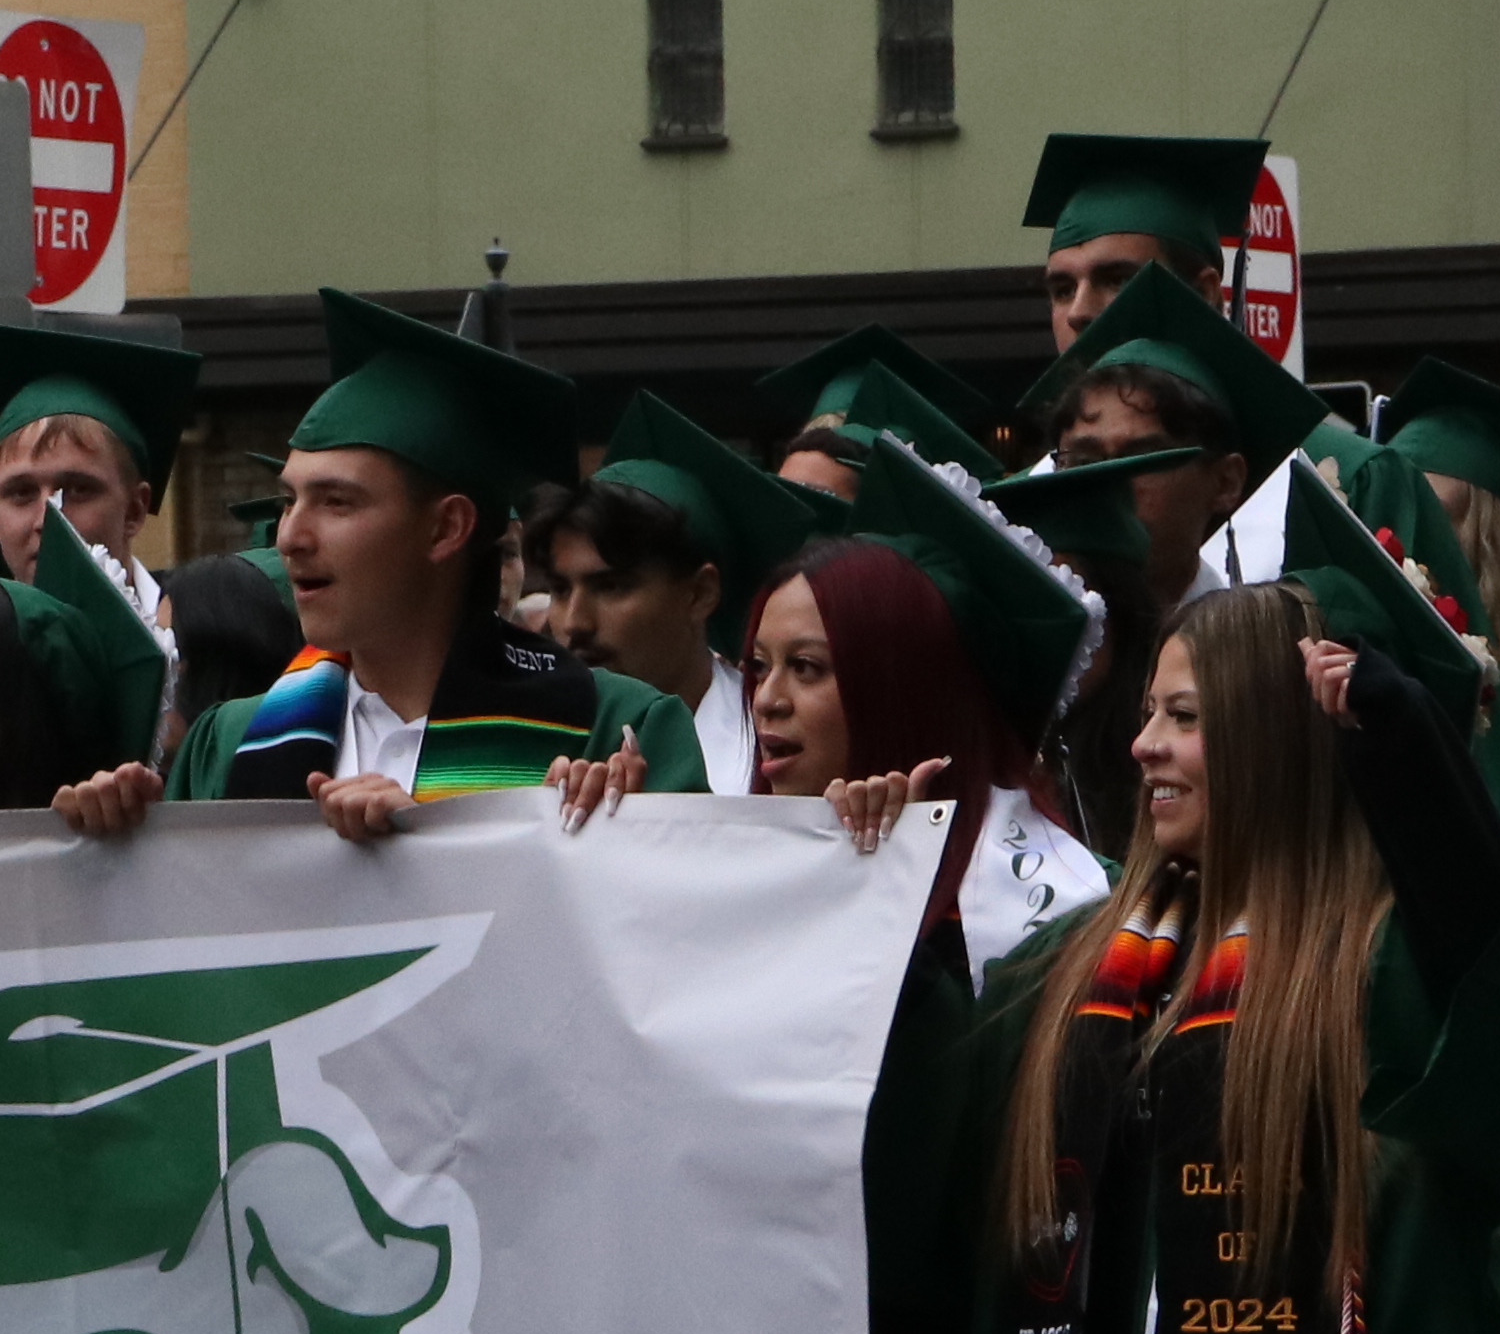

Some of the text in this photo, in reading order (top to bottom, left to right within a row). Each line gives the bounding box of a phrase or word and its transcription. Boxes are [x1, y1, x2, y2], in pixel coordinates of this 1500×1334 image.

[39, 78, 103, 124] NOT
[34, 205, 89, 251] TER
[1250, 203, 1284, 239] NOT
[505, 643, 556, 671] DENT
[1003, 820, 1055, 933] 202
[1180, 1296, 1299, 1333] 2024
